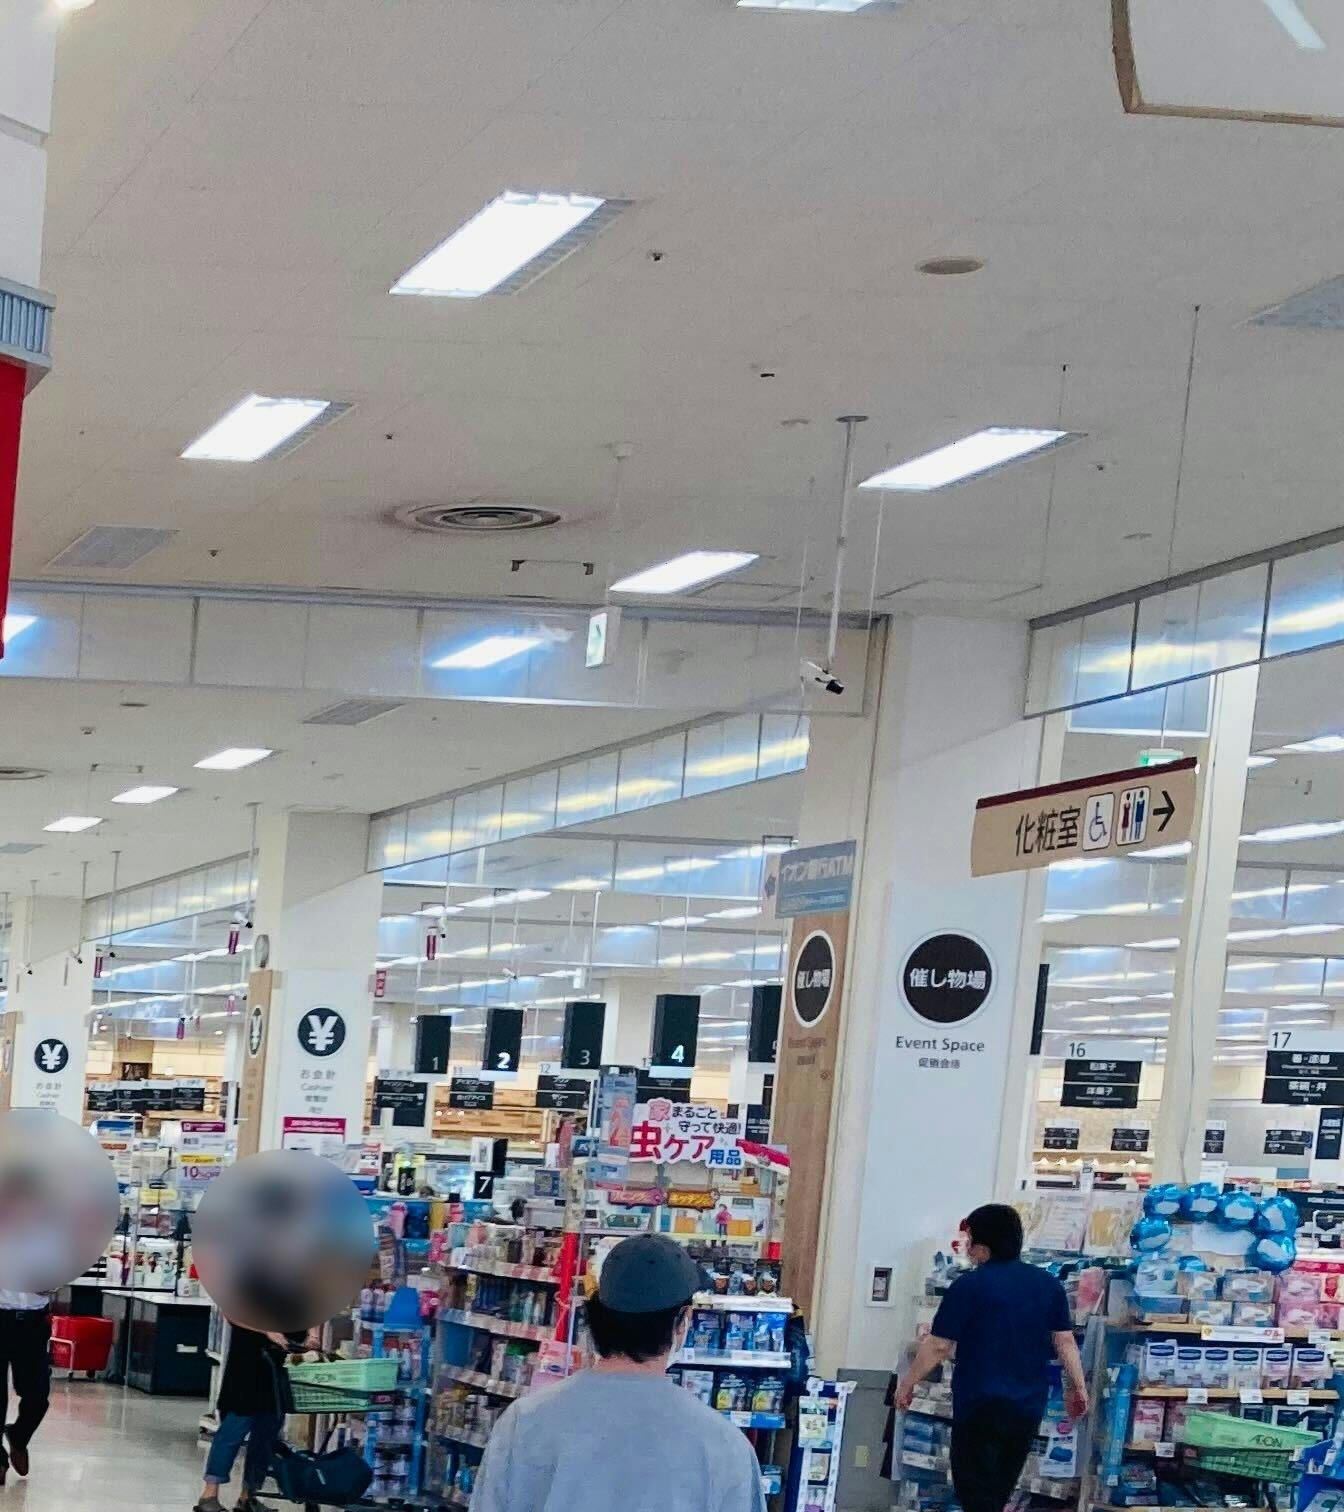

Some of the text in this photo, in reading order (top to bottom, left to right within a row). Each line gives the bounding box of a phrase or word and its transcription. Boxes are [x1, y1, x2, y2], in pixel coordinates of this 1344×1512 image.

[1015, 805, 1081, 857] 化粧室
[910, 968, 987, 990] 催し物場
[896, 1036, 985, 1053] Event Space
[1272, 1031, 1292, 1048] 17
[580, 1050, 591, 1065] 3
[671, 1044, 685, 1063] 4
[1069, 1042, 1086, 1057] 16
[432, 1056, 439, 1071] 1
[497, 1051, 511, 1069] 2
[648, 1100, 718, 1121] 家まるごと
[478, 1175, 492, 1194] 7
